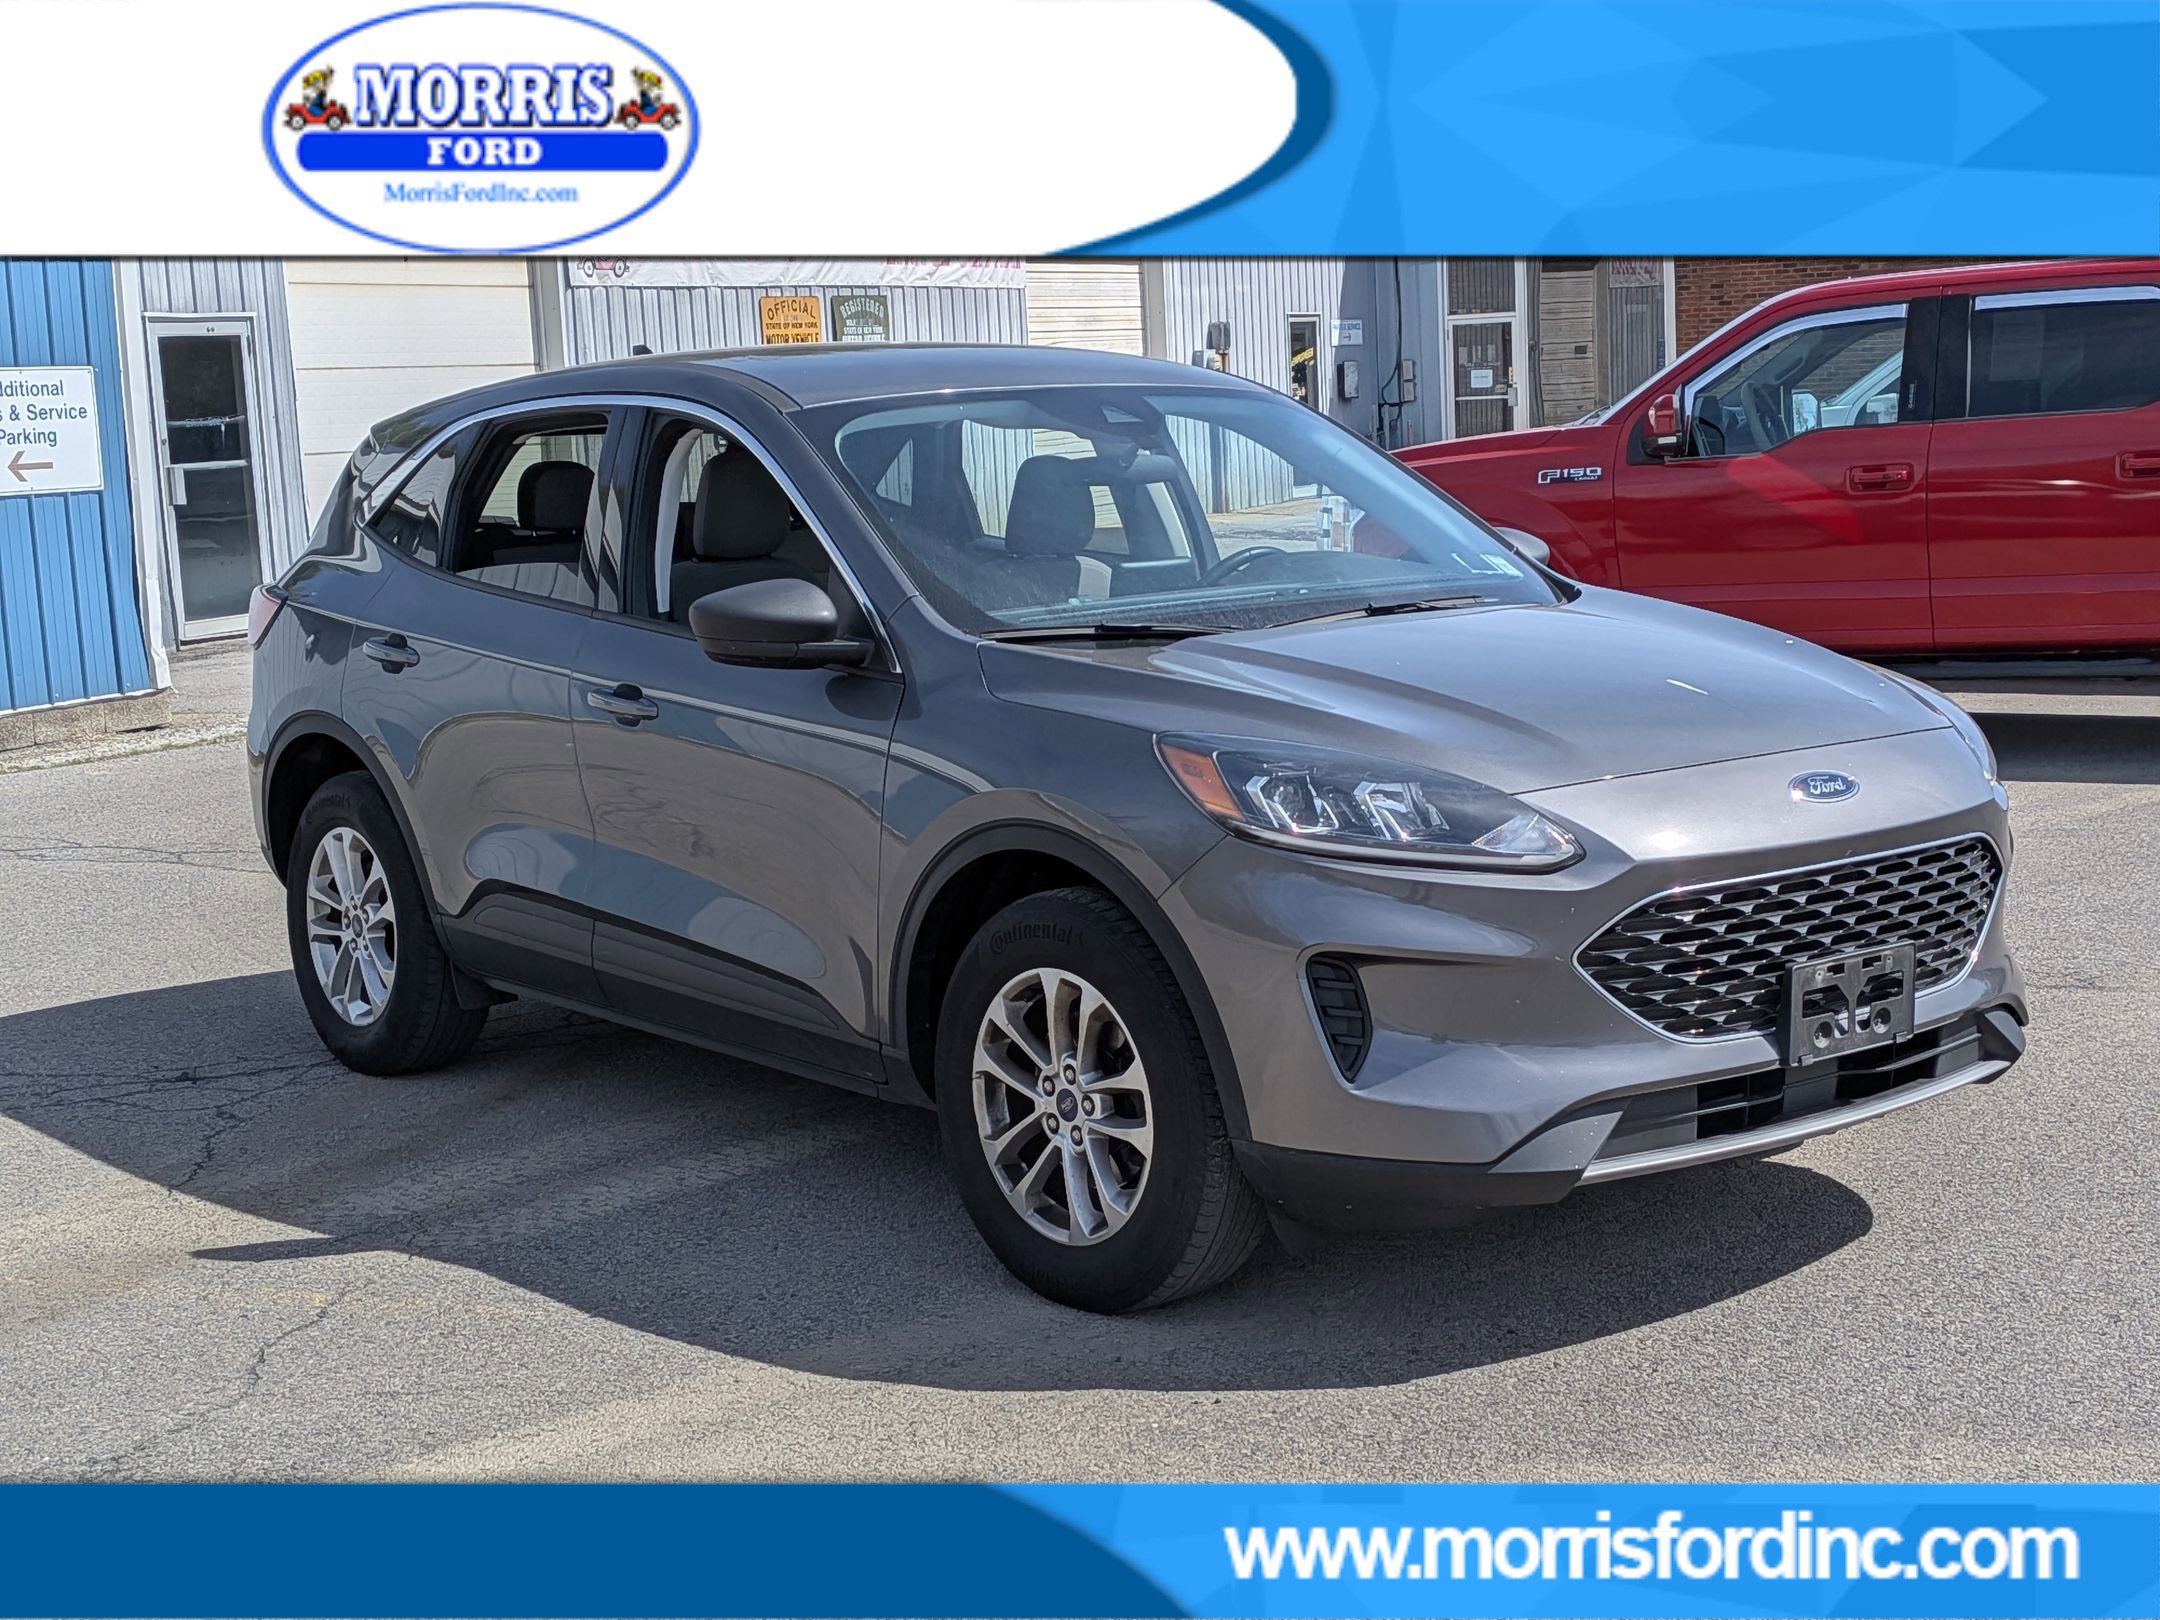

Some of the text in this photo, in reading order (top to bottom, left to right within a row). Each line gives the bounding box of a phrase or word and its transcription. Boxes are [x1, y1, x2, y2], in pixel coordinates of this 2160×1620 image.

[766, 299, 816, 320] OFFICIAL
[839, 297, 885, 319] REGISTERED
[9, 404, 20, 421] &
[27, 403, 88, 420] Service
[1808, 776, 1846, 795] Ford
[990, 923, 1073, 955] Continental
